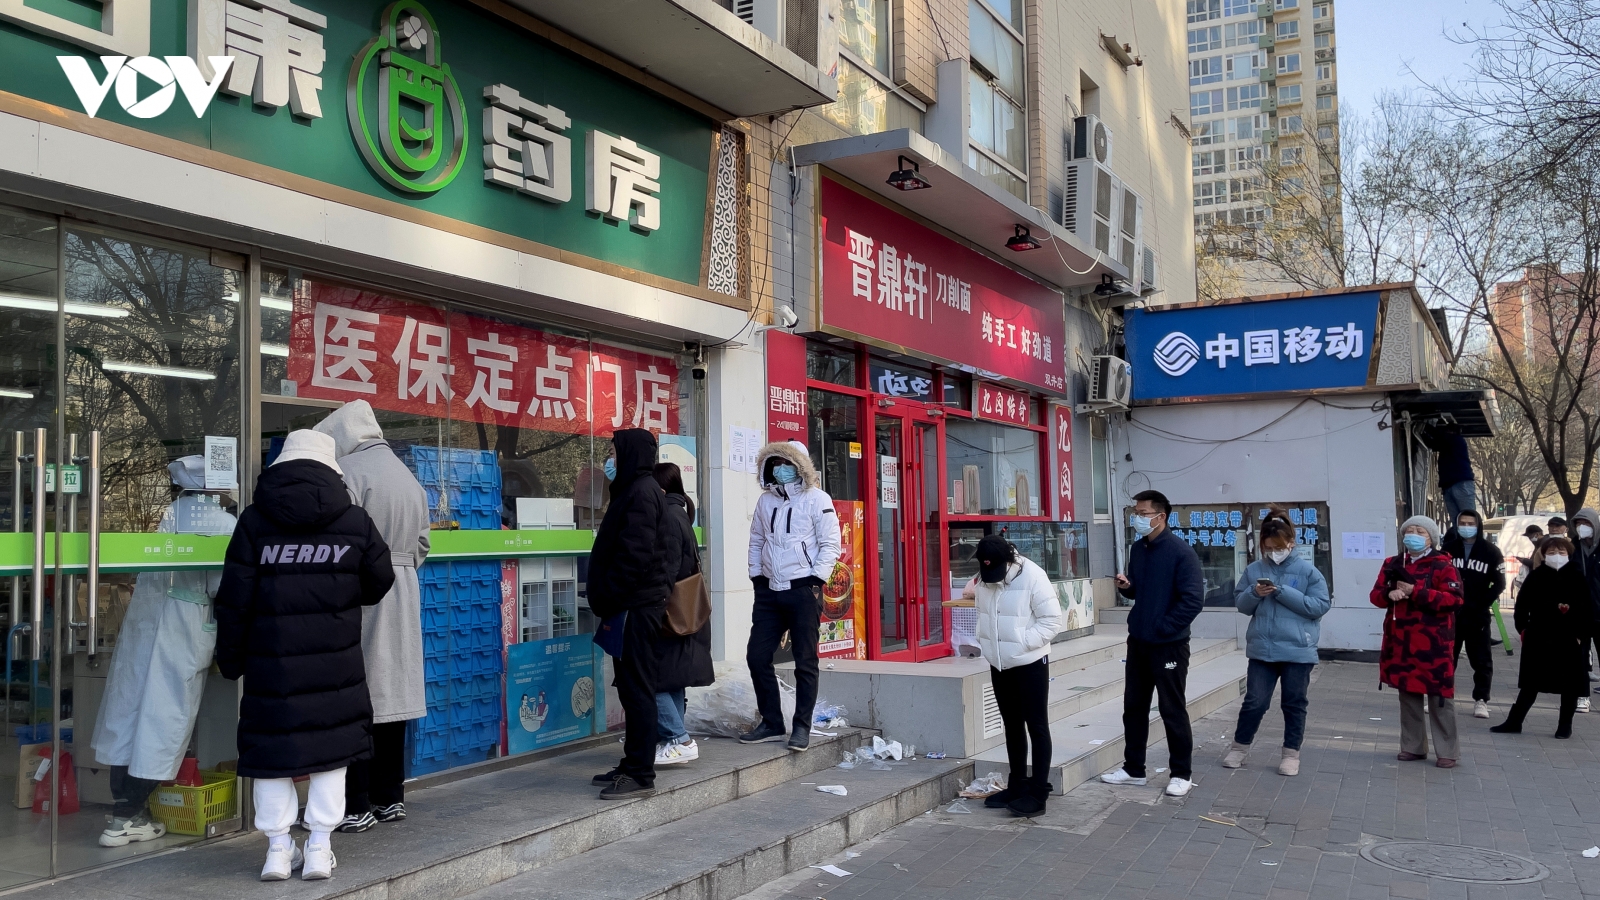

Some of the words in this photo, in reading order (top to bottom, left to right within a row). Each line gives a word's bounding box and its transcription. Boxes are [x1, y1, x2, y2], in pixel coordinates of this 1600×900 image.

[483, 83, 661, 231] 药房
[848, 230, 928, 320] 晋鼎轩
[936, 272, 971, 314] 刀削面
[982, 311, 1017, 349] 纯手工
[1021, 326, 1052, 363] 好劲道
[1205, 322, 1363, 369] 中国移动
[311, 302, 671, 433] 医保定点门店
[1044, 373, 1063, 390] 双井店
[770, 385, 806, 416] 晋鼎轩
[64, 472, 77, 485] 拉
[1190, 511, 1242, 527] 报装宽带
[1259, 508, 1317, 525] 手贴膜
[1134, 529, 1237, 547] 种卡号业务
[260, 544, 351, 565] NERDY
[1467, 559, 1489, 574] KUI
